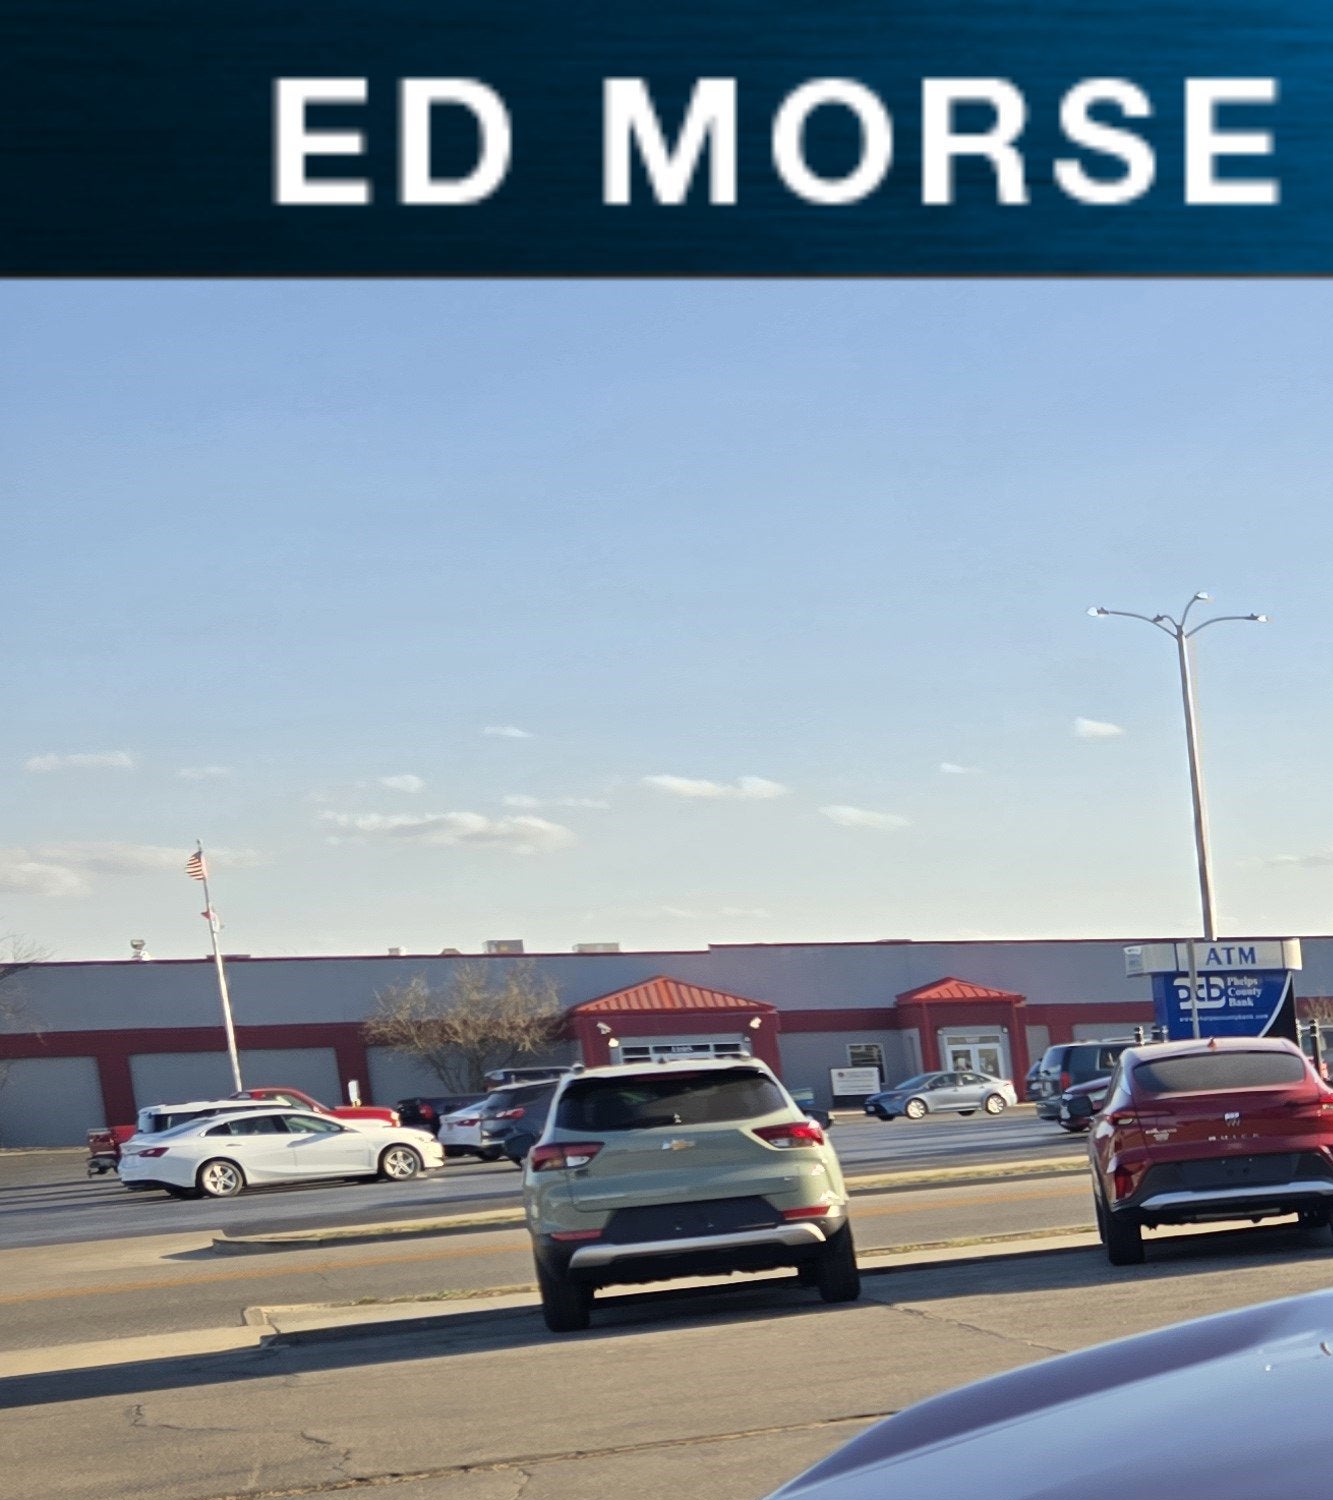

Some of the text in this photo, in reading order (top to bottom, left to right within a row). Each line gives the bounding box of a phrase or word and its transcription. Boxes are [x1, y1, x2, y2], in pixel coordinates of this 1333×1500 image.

[1205, 946, 1257, 966] ATM
[1227, 976, 1259, 987] Phelps
[1227, 987, 1263, 998] County
[1228, 997, 1254, 1008] Bank
